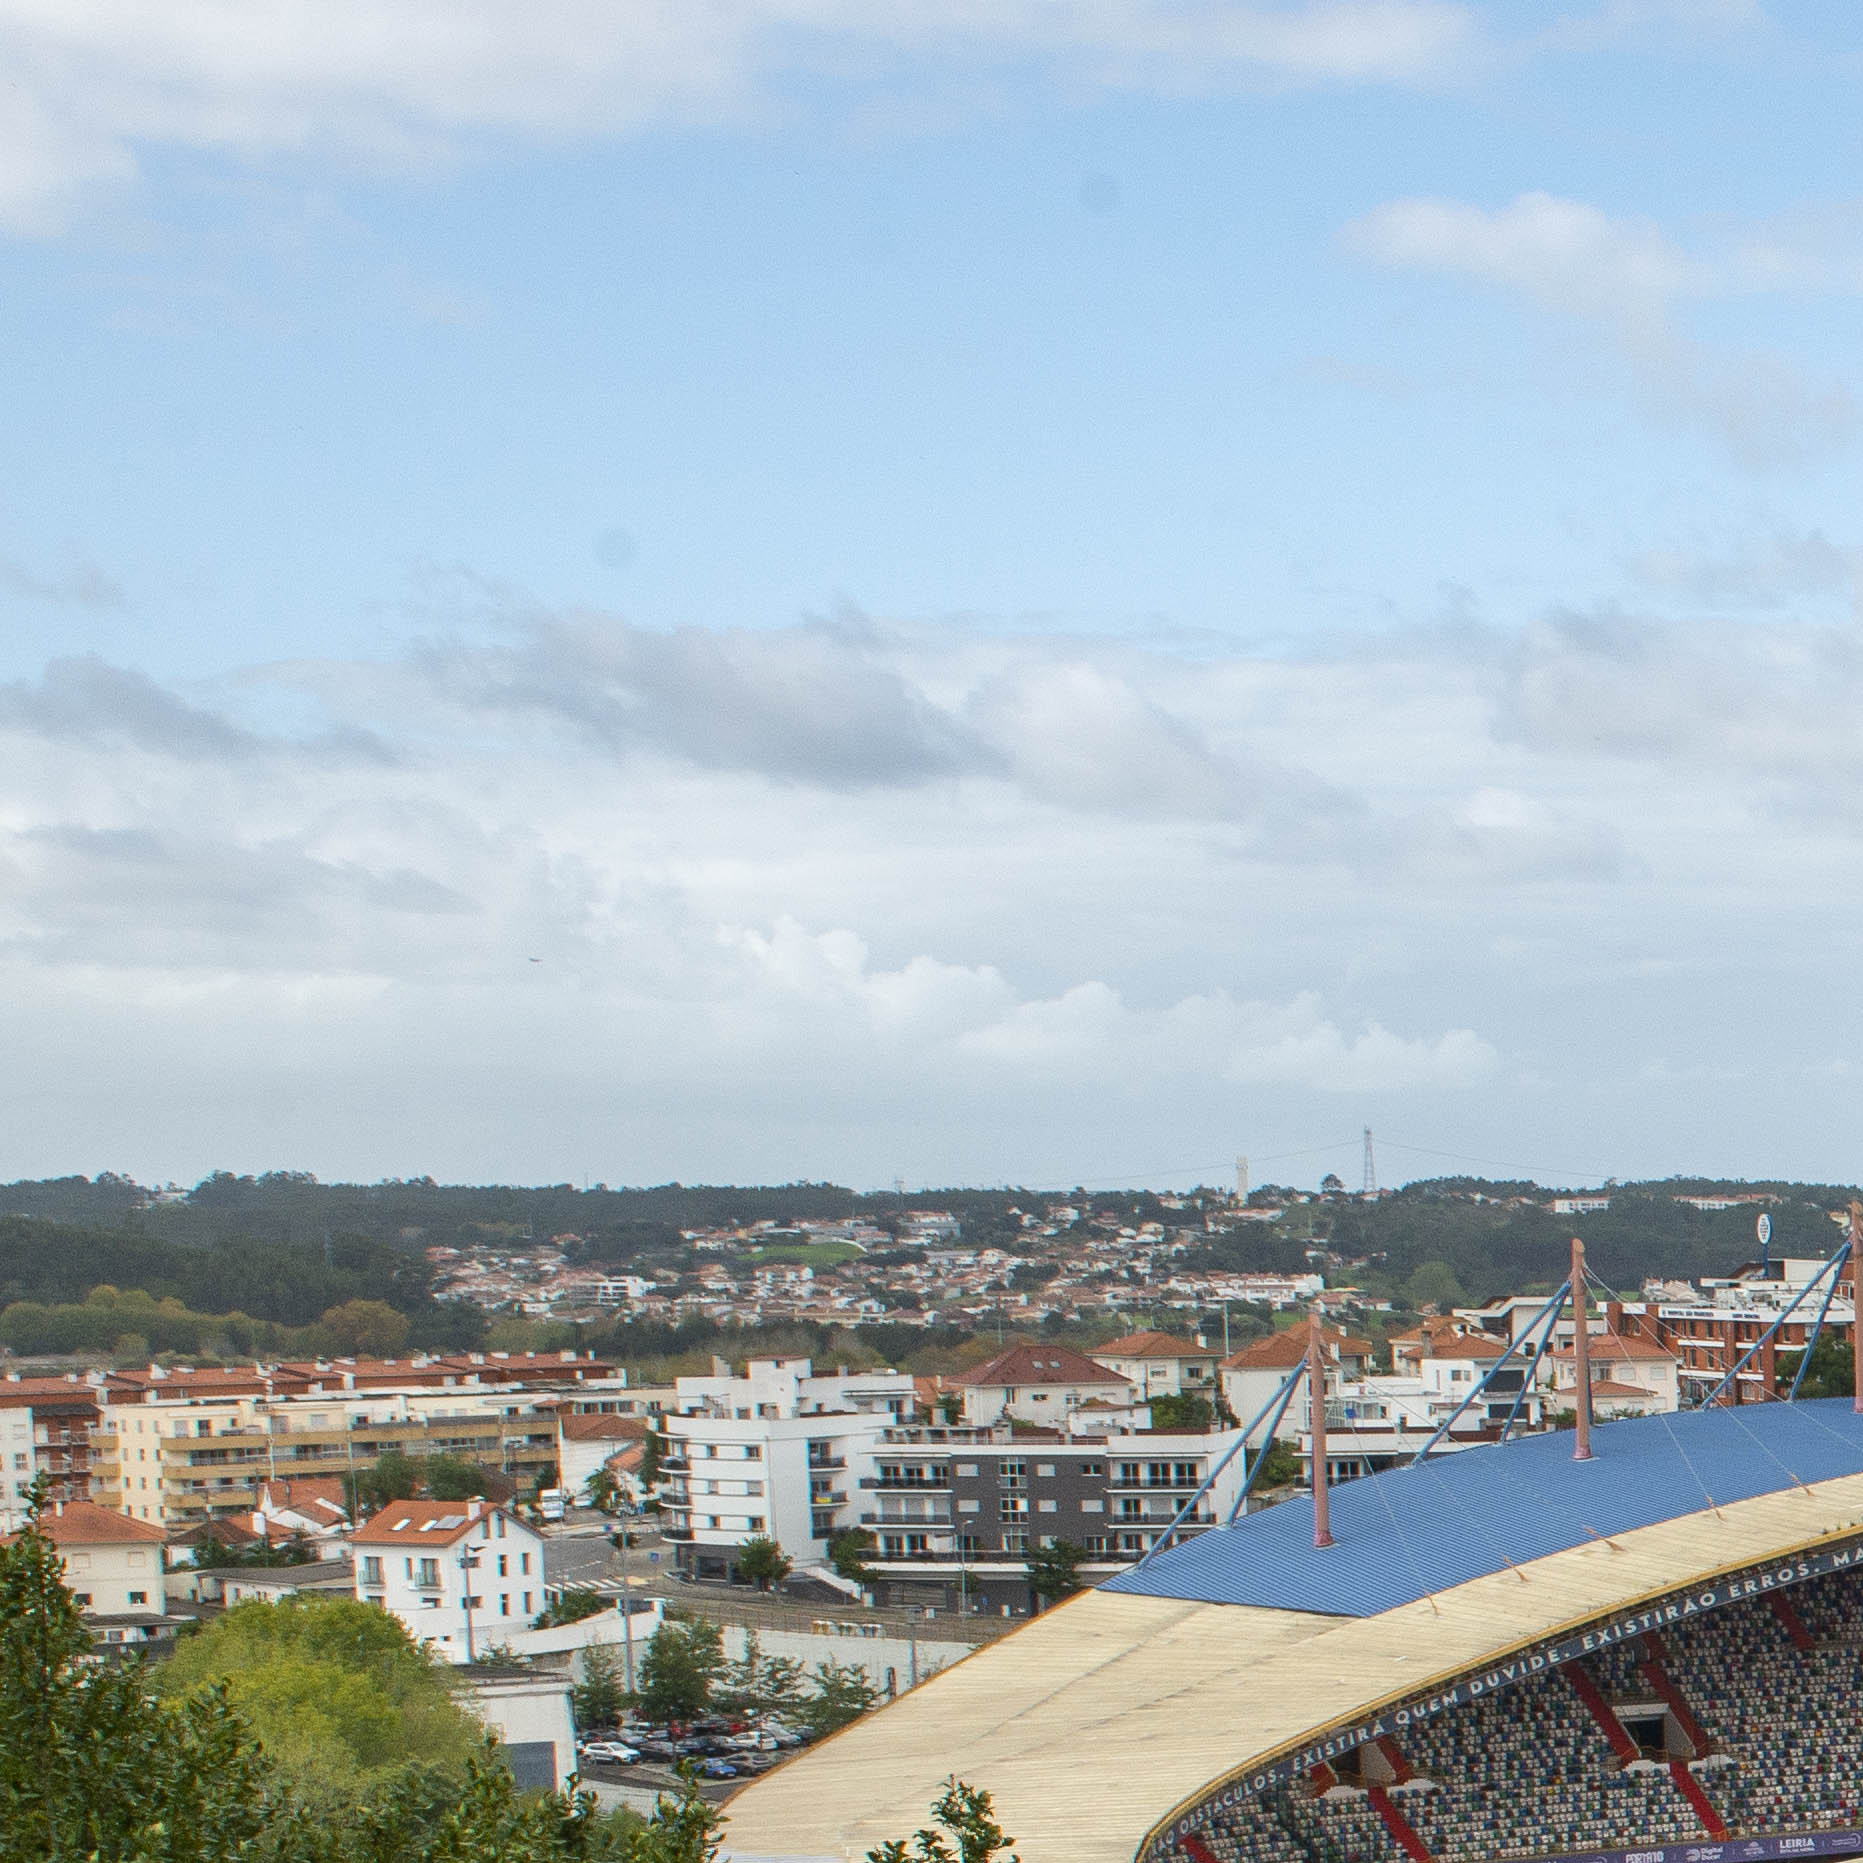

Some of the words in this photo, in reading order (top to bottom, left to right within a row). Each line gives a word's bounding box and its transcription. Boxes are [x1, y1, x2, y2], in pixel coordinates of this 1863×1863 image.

[1395, 1689, 1459, 1725] QUEM
[1470, 1649, 1571, 1694] DUVIDE.
[1582, 1592, 1716, 1650] EXISTIRÃO
[1729, 1563, 1820, 1598] ERROS.
[1779, 1838, 1815, 1849] LEIRIA
